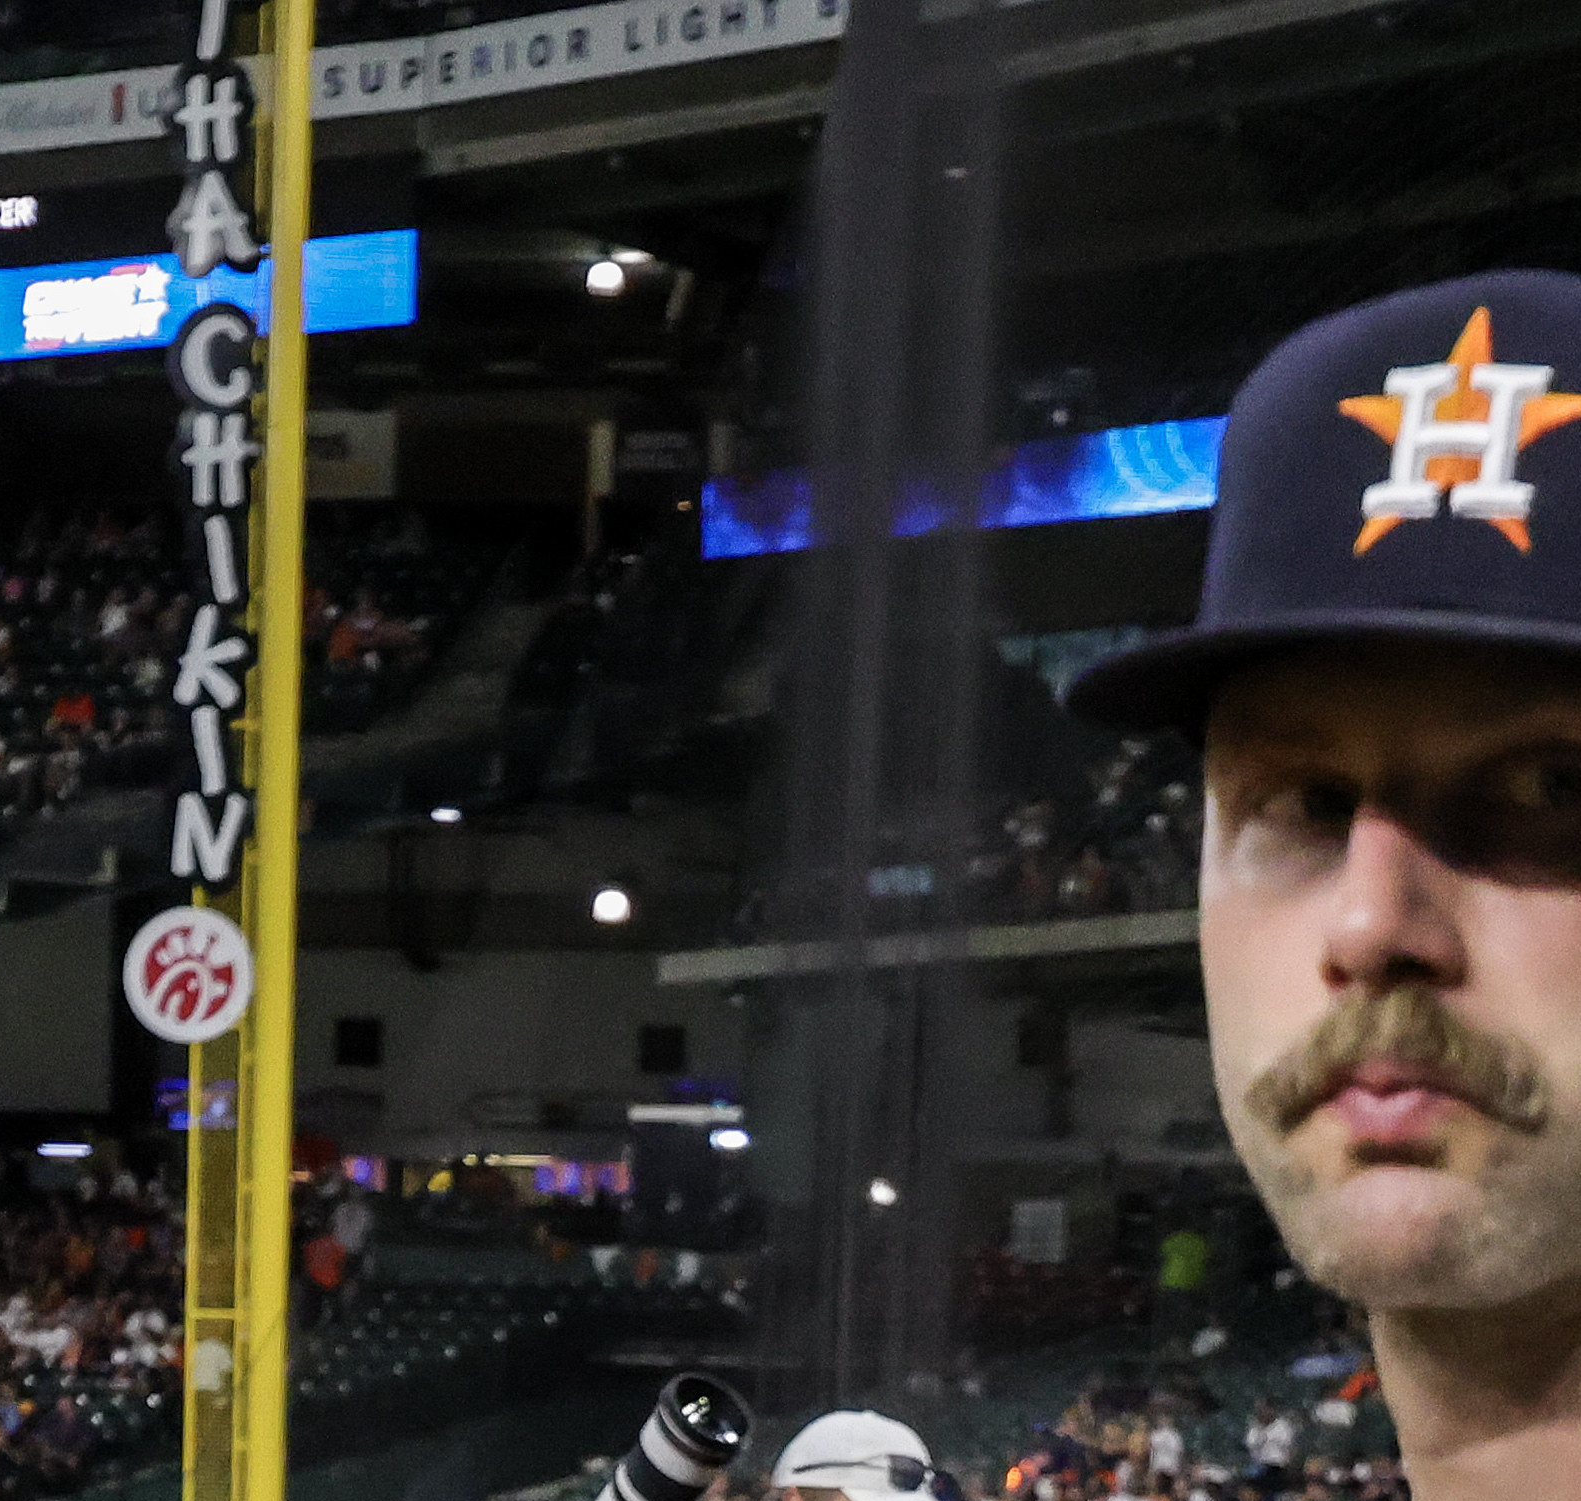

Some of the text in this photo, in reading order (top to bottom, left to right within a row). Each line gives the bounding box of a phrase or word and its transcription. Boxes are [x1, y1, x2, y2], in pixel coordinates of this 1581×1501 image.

[323, 27, 591, 98] SUPERIOR
[1360, 361, 1556, 520] H
[171, 313, 263, 882] CHIKIN
